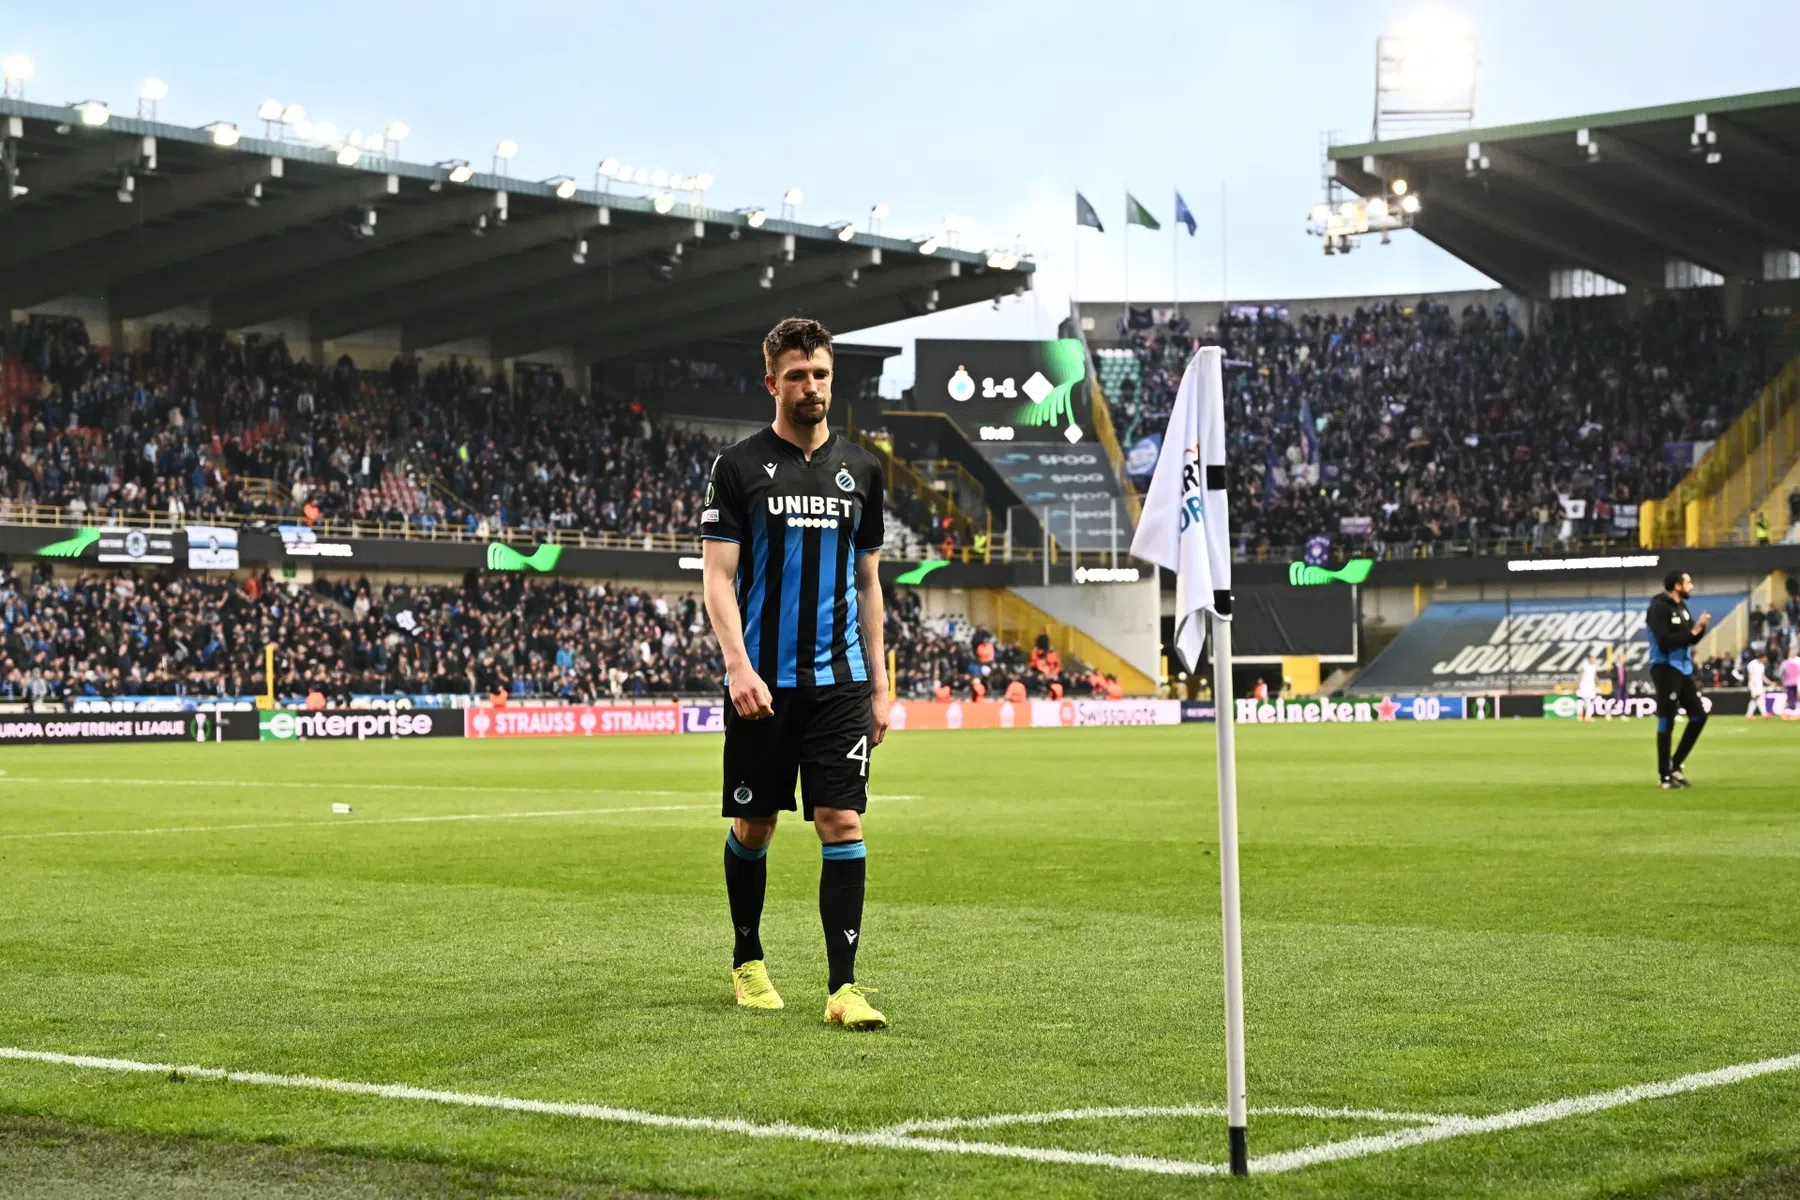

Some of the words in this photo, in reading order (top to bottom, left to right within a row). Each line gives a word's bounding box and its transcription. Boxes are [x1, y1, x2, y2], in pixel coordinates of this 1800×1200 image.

[768, 496, 852, 518] UNIBET
[495, 711, 576, 733] STRAUSS
[601, 710, 676, 731] STRAUSS
[1235, 697, 1373, 723] Heineken
[45, 722, 134, 737] CONFERENCE
[135, 720, 185, 735] LEAGUE
[260, 708, 432, 740] enterprise
[846, 735, 870, 776] 4
